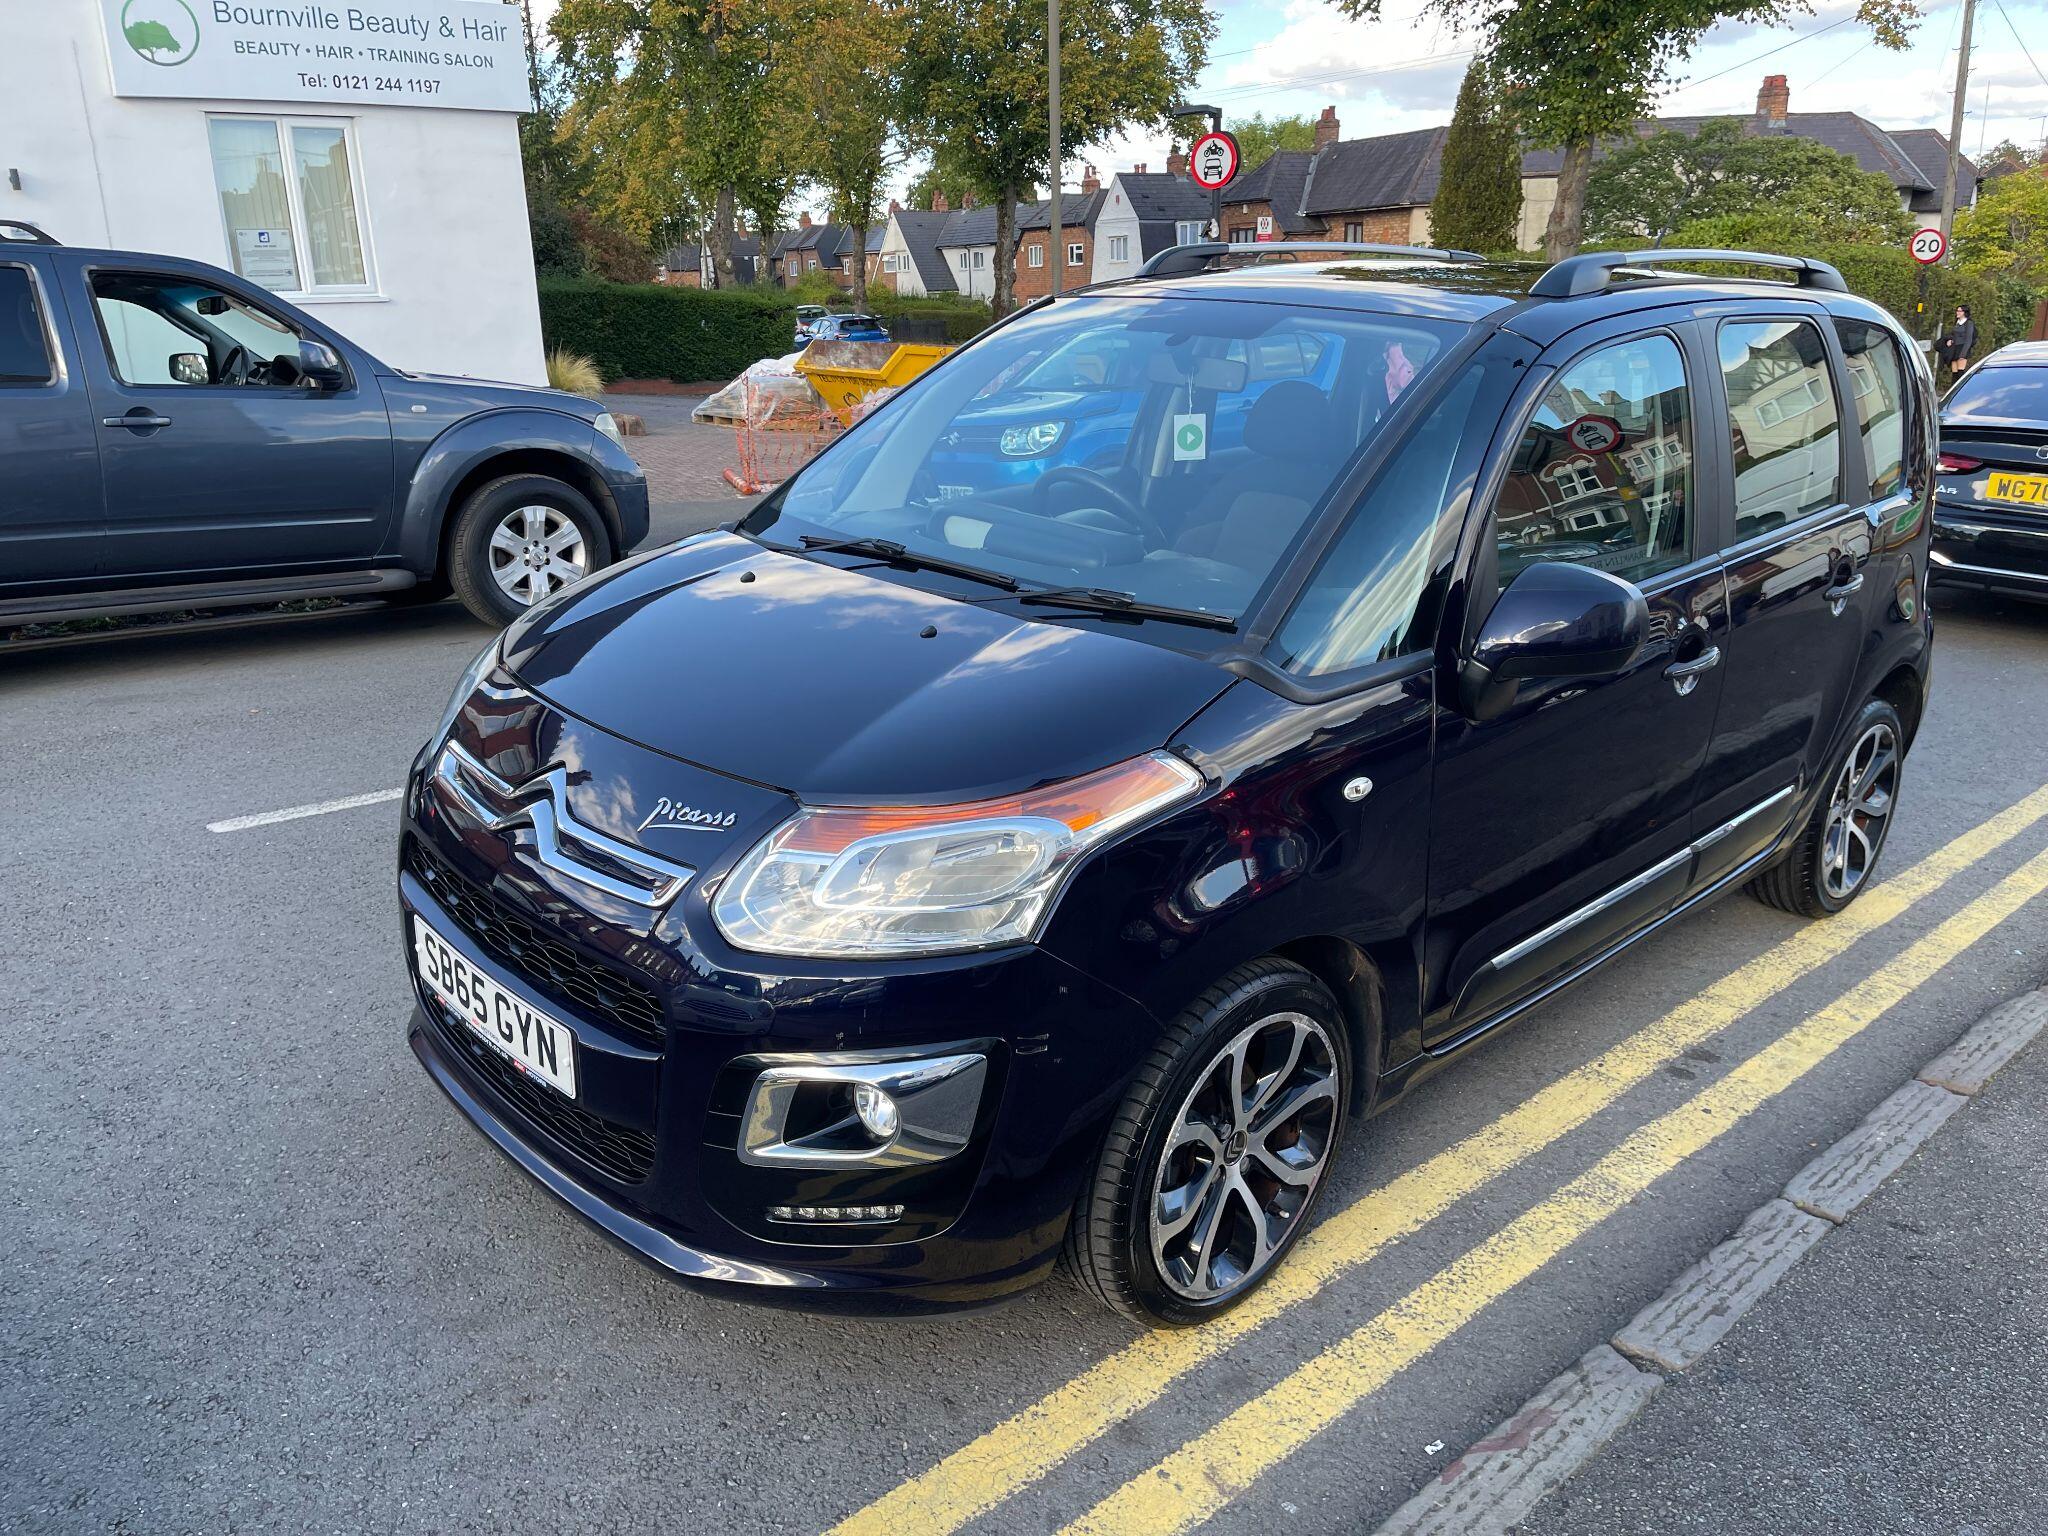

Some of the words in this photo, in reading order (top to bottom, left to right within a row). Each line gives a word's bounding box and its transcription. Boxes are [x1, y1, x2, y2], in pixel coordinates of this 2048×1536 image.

[213, 0, 340, 30] Bournville
[347, 8, 430, 41] Beauty
[438, 15, 456, 38] &
[462, 17, 508, 42] Hair
[234, 40, 301, 56] BEAUTY
[315, 44, 354, 59] HAIR
[367, 47, 440, 65] TRAINING
[444, 53, 494, 69] SALON
[297, 72, 328, 88] Tel:
[332, 74, 369, 90] 0121
[374, 76, 402, 92] 244
[407, 78, 441, 94] 1197
[1915, 239, 1940, 253] 20
[637, 796, 737, 832] Picasso
[425, 932, 488, 1024] SB65
[494, 991, 558, 1077] GYN
